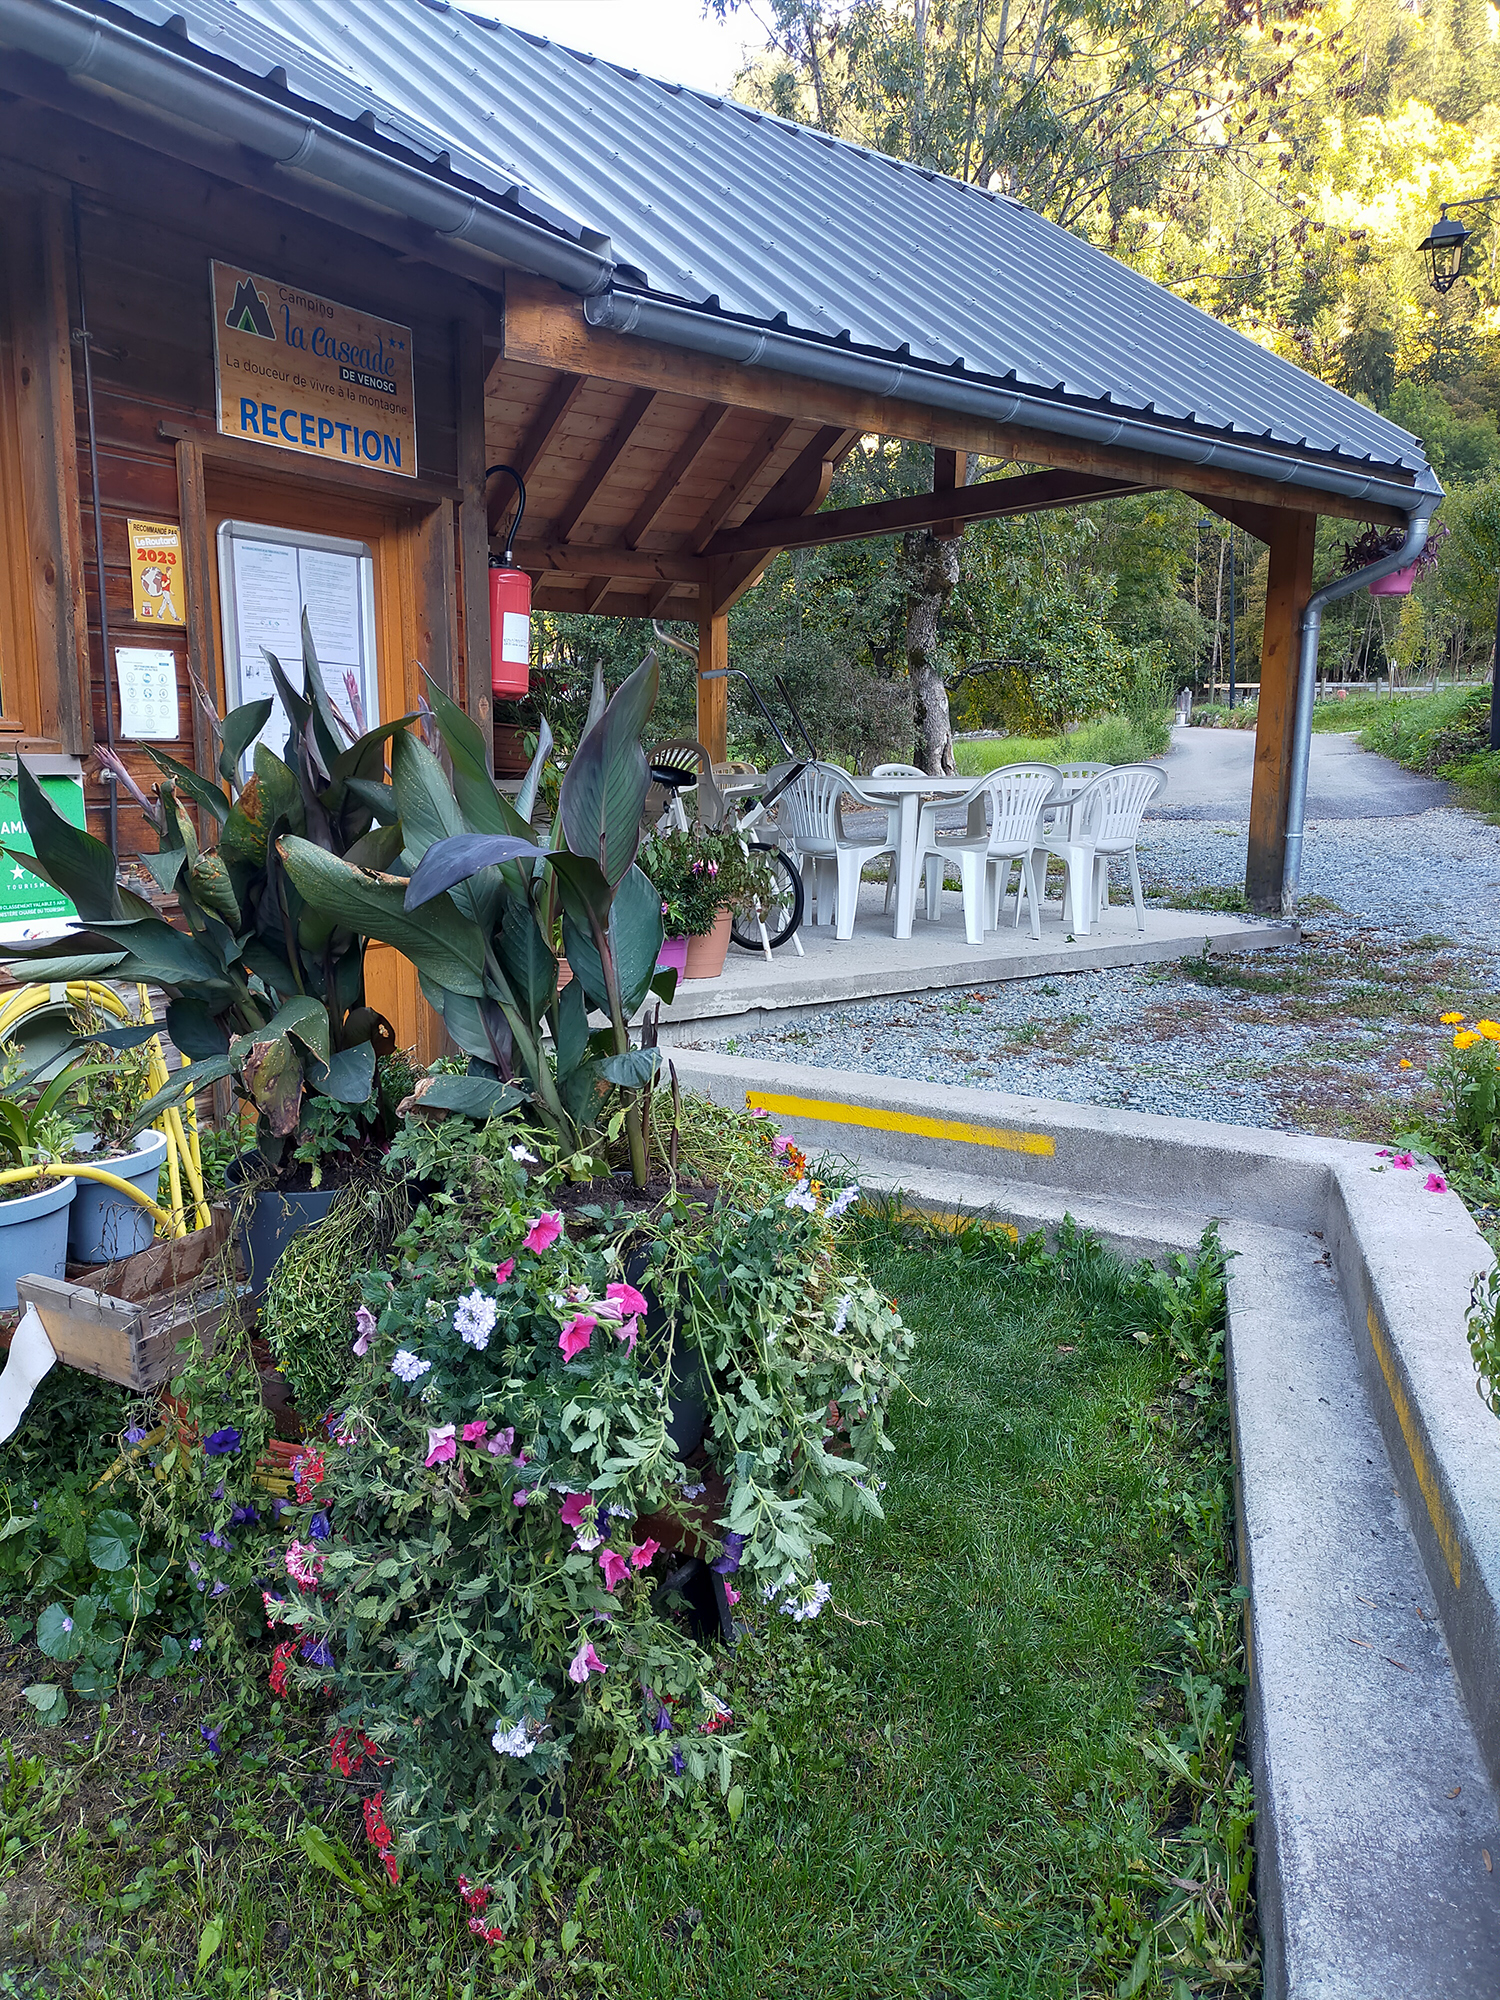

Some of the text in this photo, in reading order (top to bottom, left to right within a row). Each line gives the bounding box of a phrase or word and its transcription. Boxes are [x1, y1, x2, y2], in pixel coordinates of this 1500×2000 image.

[279, 288, 333, 318] Camping
[312, 327, 396, 377] Cascade
[226, 354, 407, 415] La douceur de vivre à la montagne
[342, 368, 395, 393] DE VENOSC
[240, 397, 401, 467] RECEPTION
[133, 523, 167, 535] RECOMMANDÉ
[137, 548, 177, 565] 2023
